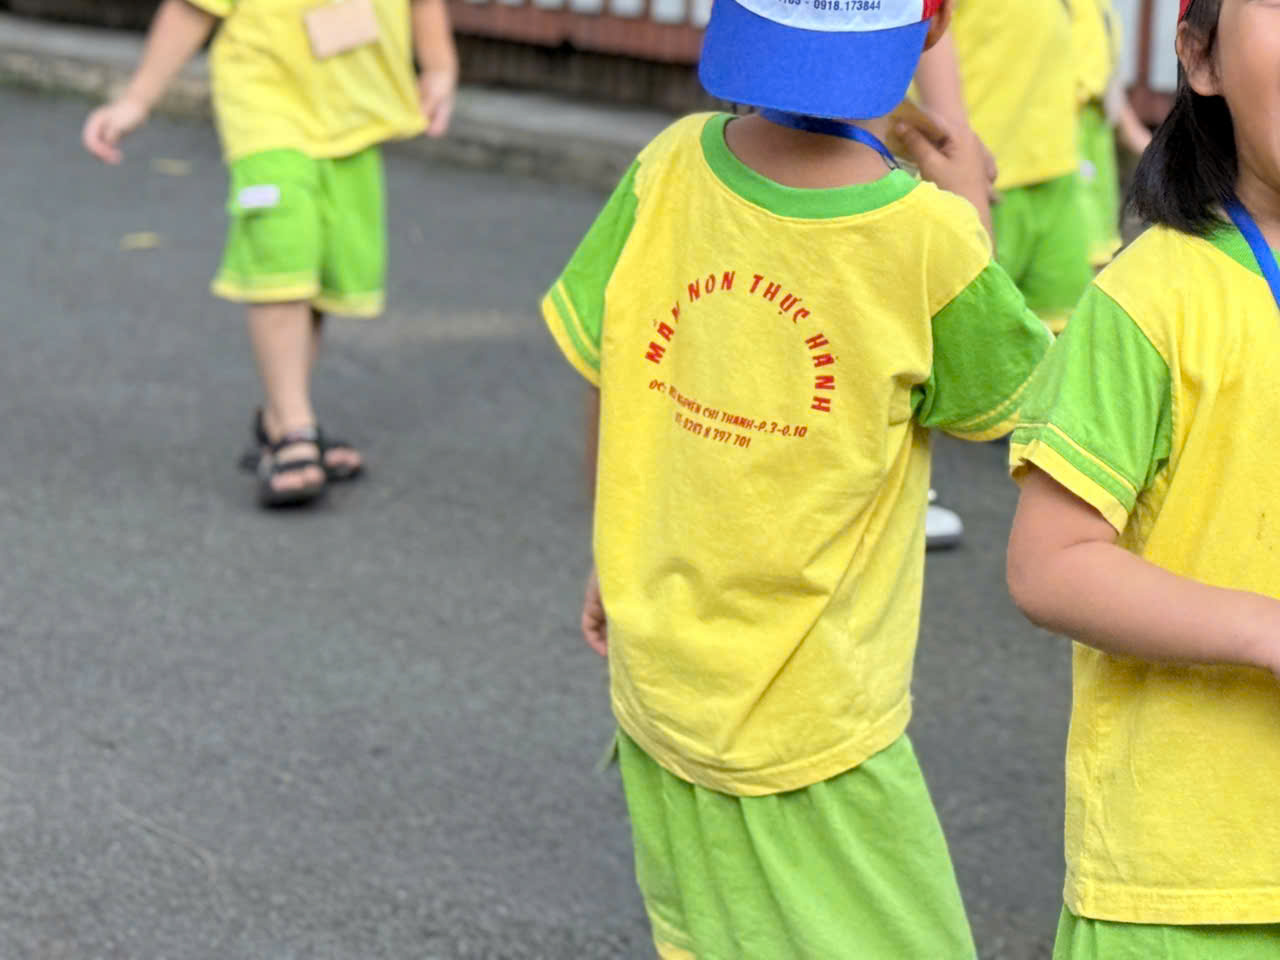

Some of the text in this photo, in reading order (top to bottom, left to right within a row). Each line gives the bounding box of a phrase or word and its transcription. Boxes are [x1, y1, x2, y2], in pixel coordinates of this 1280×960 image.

[687, 270, 736, 303] NON
[749, 273, 811, 325] THỰC
[804, 332, 840, 413] HÀNH
[732, 433, 753, 449] 701
